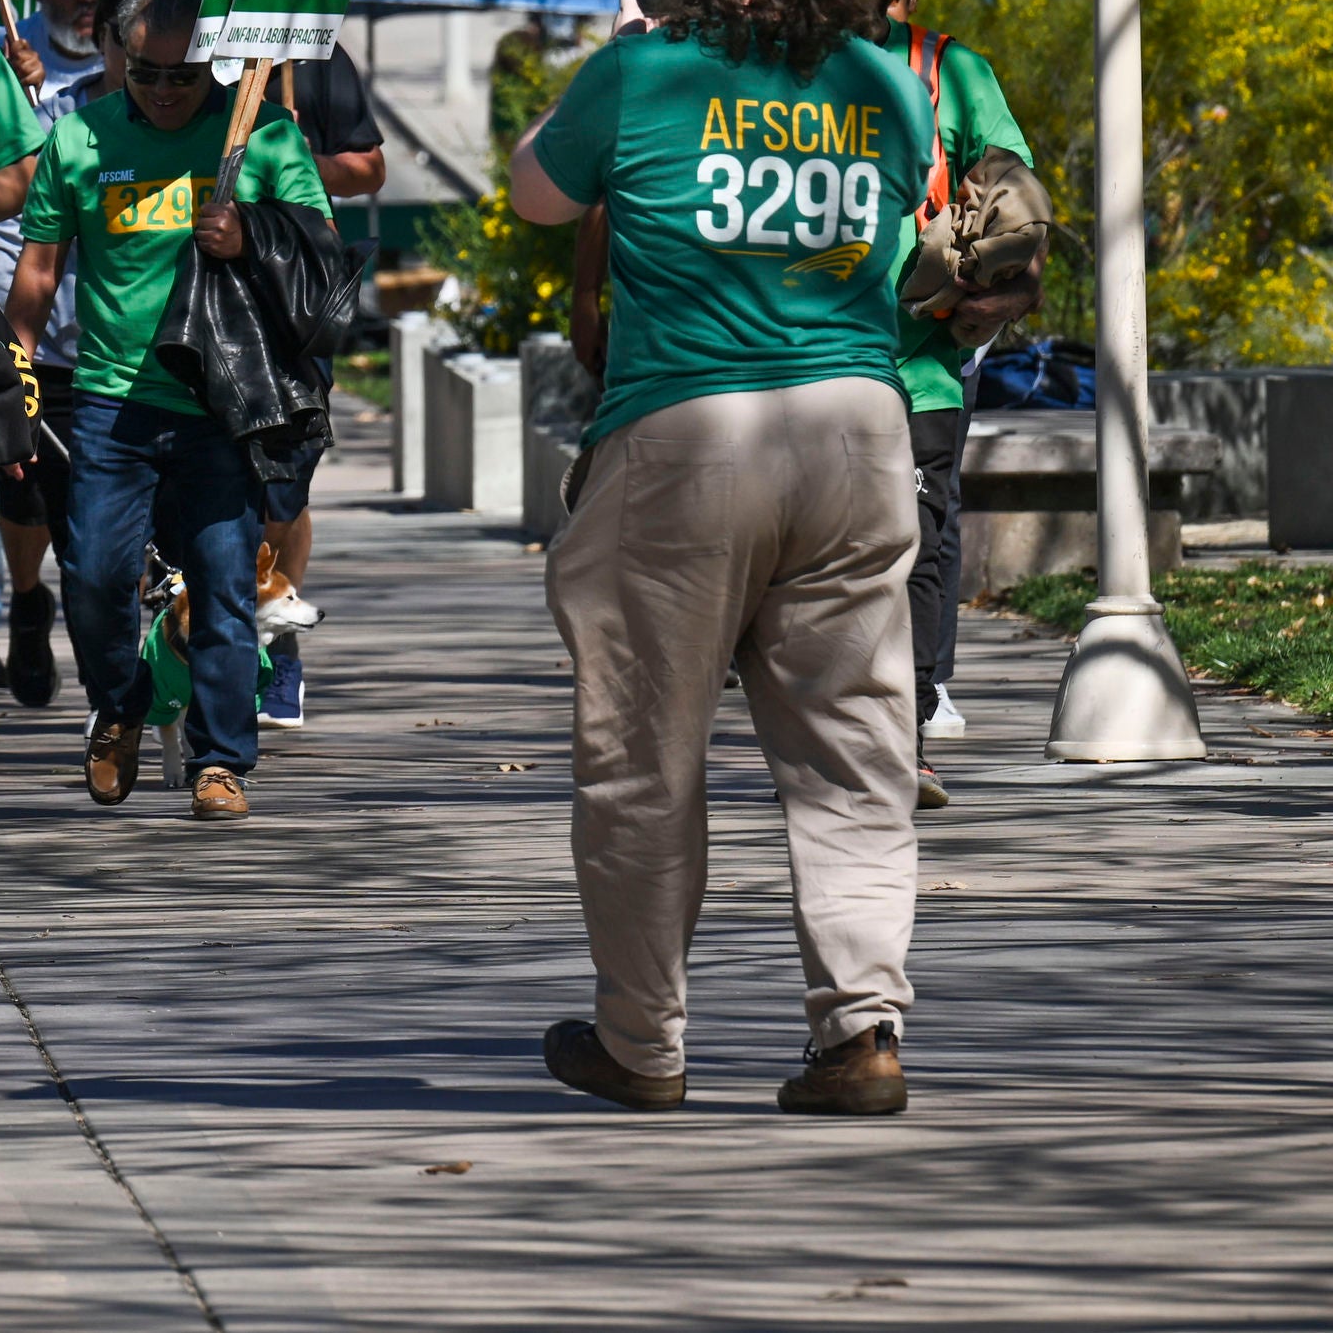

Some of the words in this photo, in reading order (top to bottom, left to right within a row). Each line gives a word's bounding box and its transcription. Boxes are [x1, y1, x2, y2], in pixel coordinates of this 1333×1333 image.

[197, 32, 219, 48] UNF
[227, 26, 261, 44] UNFAIR
[259, 28, 290, 45] LABOR
[289, 28, 334, 47] PRACTICE
[700, 97, 882, 158] AFSCME
[98, 169, 135, 184] AFSCME
[695, 154, 882, 248] 3299
